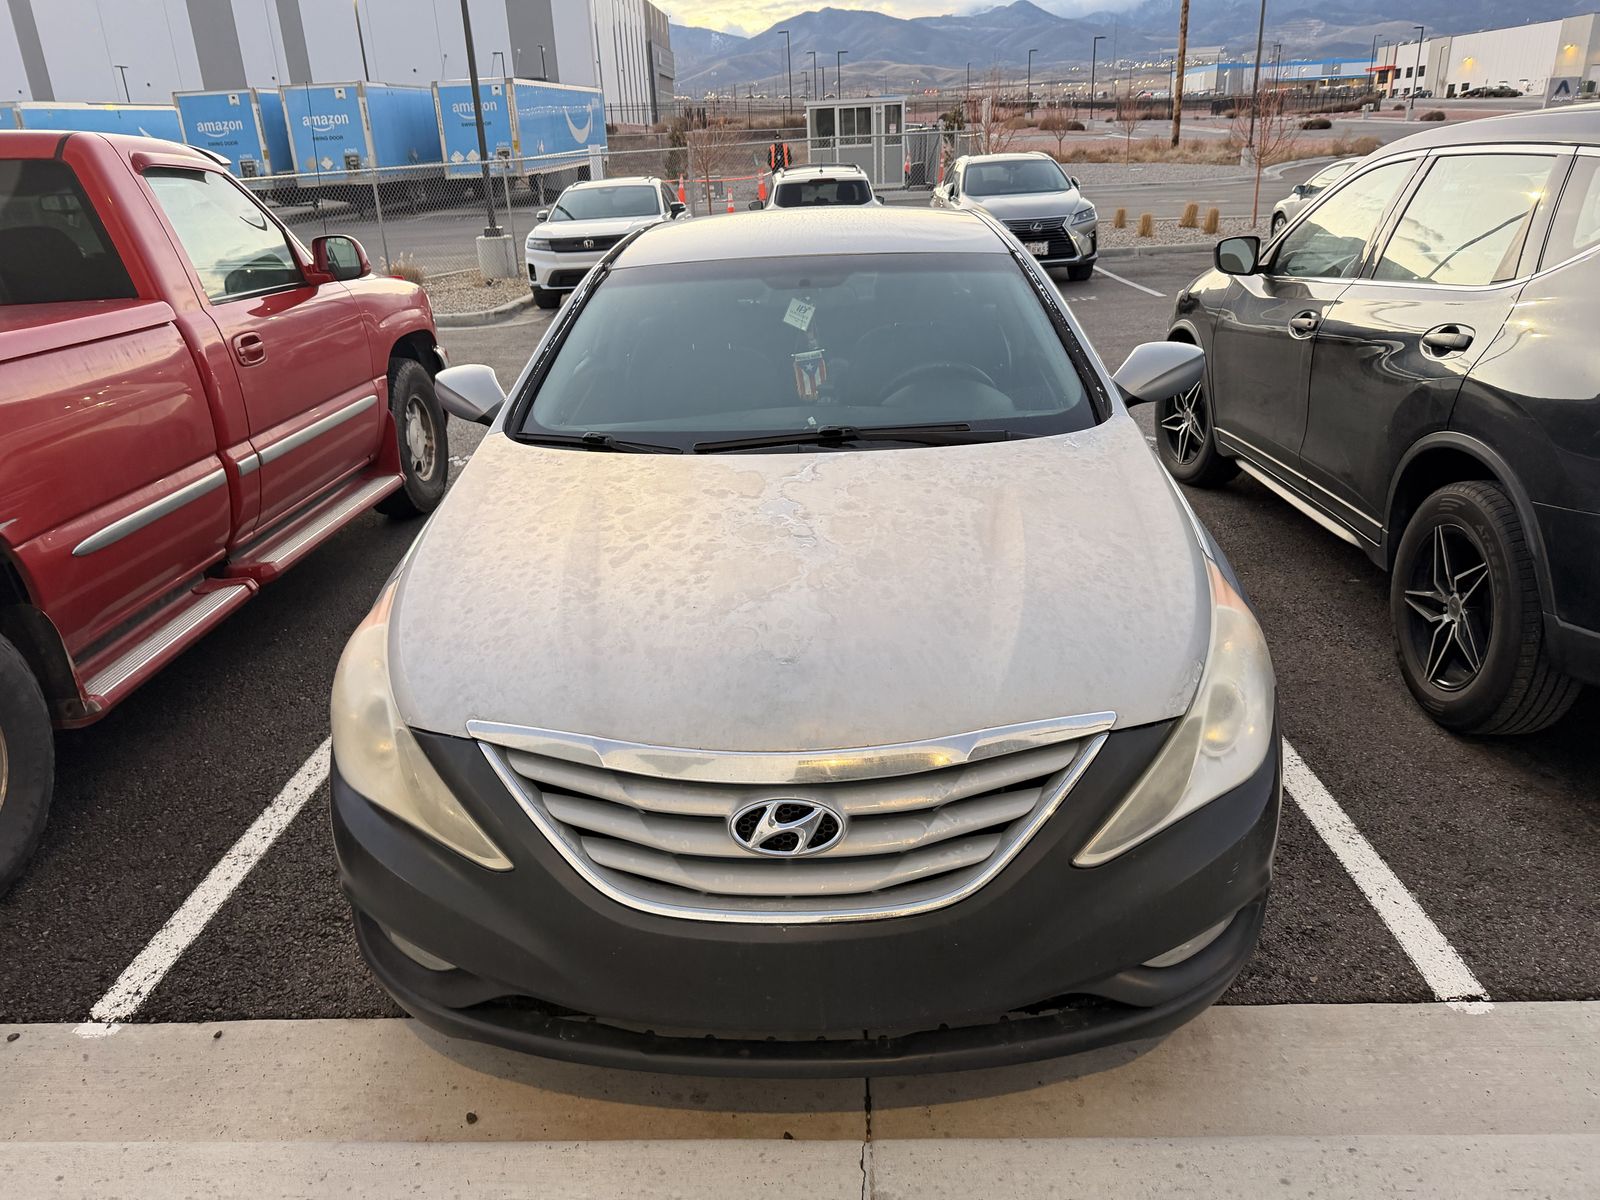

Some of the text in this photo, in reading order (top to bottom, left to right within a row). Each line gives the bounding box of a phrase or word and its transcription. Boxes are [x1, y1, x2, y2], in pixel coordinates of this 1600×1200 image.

[452, 100, 498, 113] amaon
[302, 113, 349, 126] amazon
[196, 120, 243, 133] amazon
